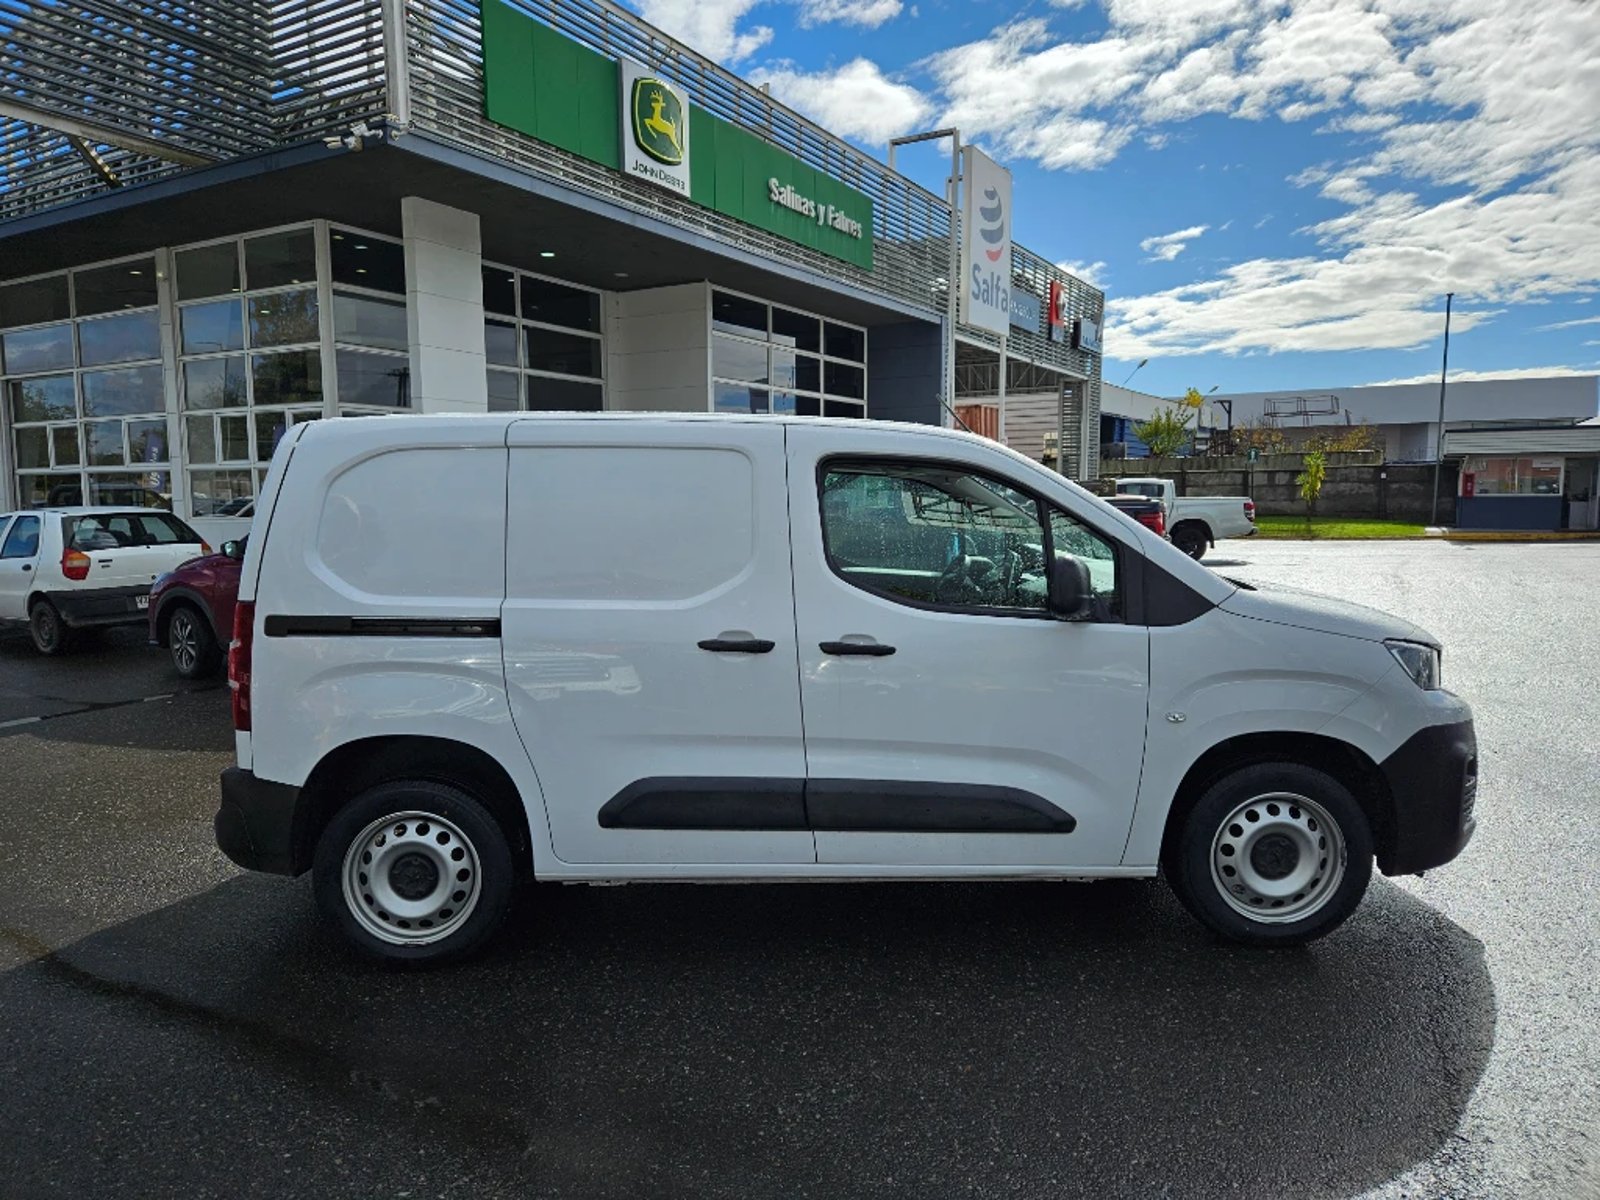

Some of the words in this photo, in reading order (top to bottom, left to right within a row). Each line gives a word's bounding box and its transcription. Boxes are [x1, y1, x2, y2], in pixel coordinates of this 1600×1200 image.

[632, 159, 658, 178] JOHN
[768, 177, 816, 218] Salinas
[817, 204, 826, 226] y
[826, 204, 863, 240] Fabres
[972, 262, 1009, 313] Salfa
